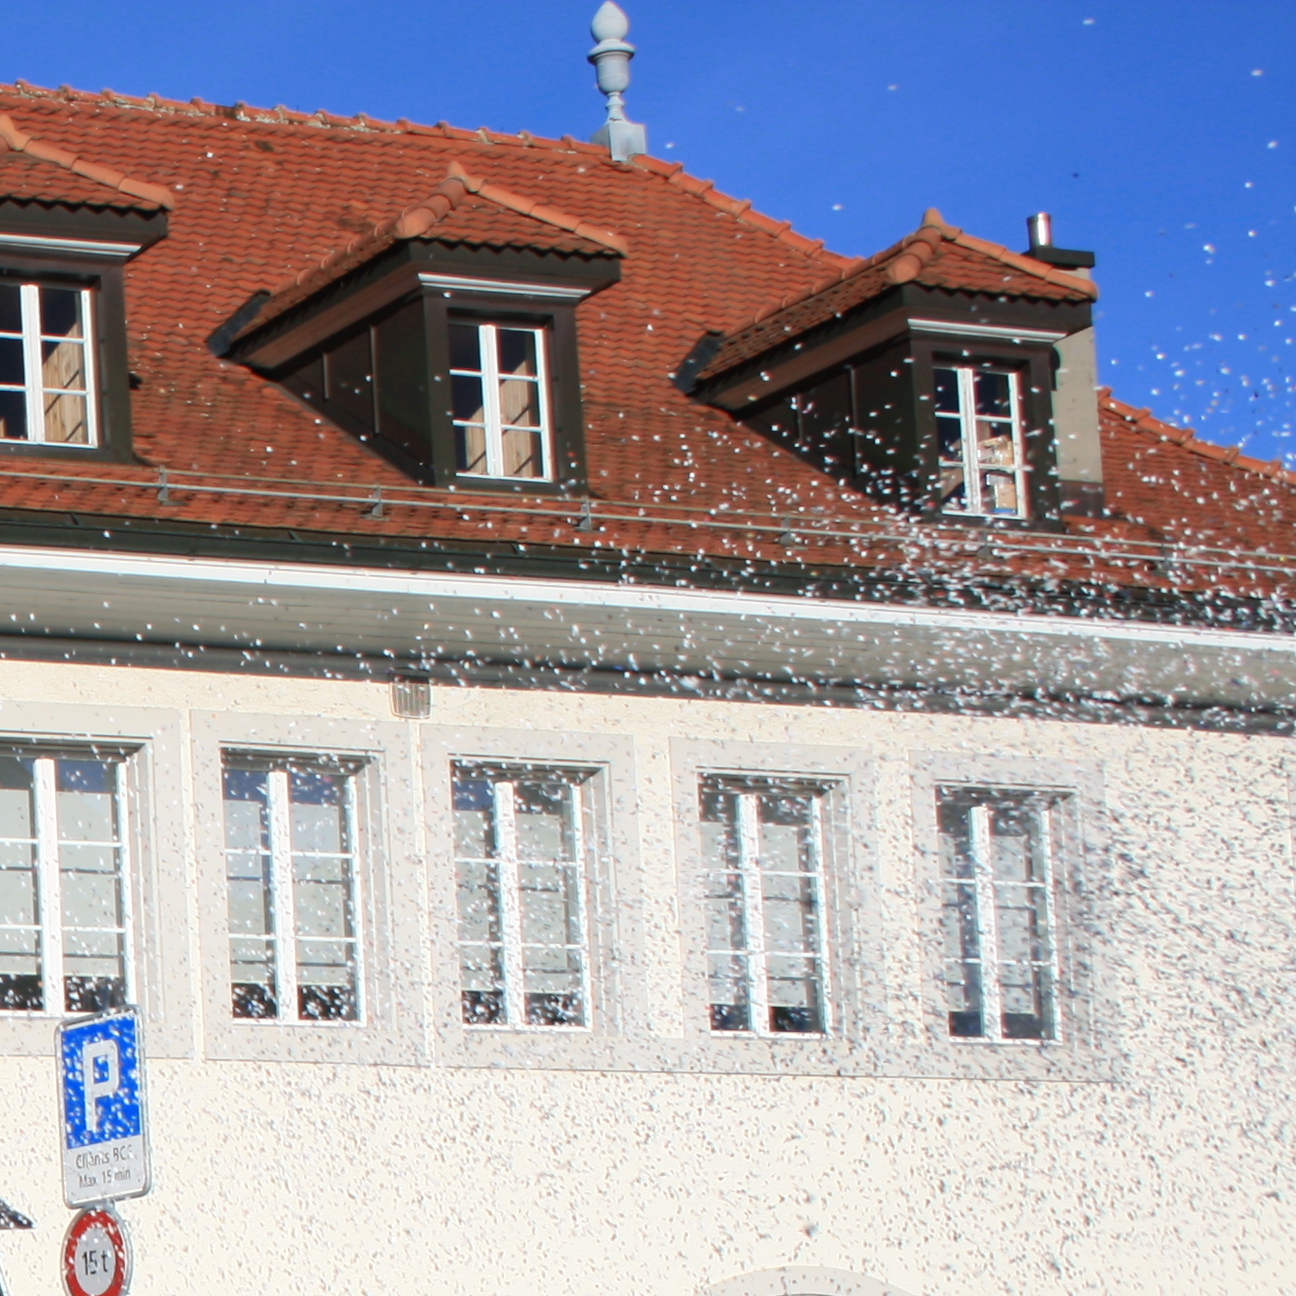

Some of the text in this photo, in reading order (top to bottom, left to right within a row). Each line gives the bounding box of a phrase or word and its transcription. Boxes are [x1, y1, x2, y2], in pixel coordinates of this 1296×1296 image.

[82, 1040, 120, 1133] P
[82, 1250, 109, 1275] 15 t
